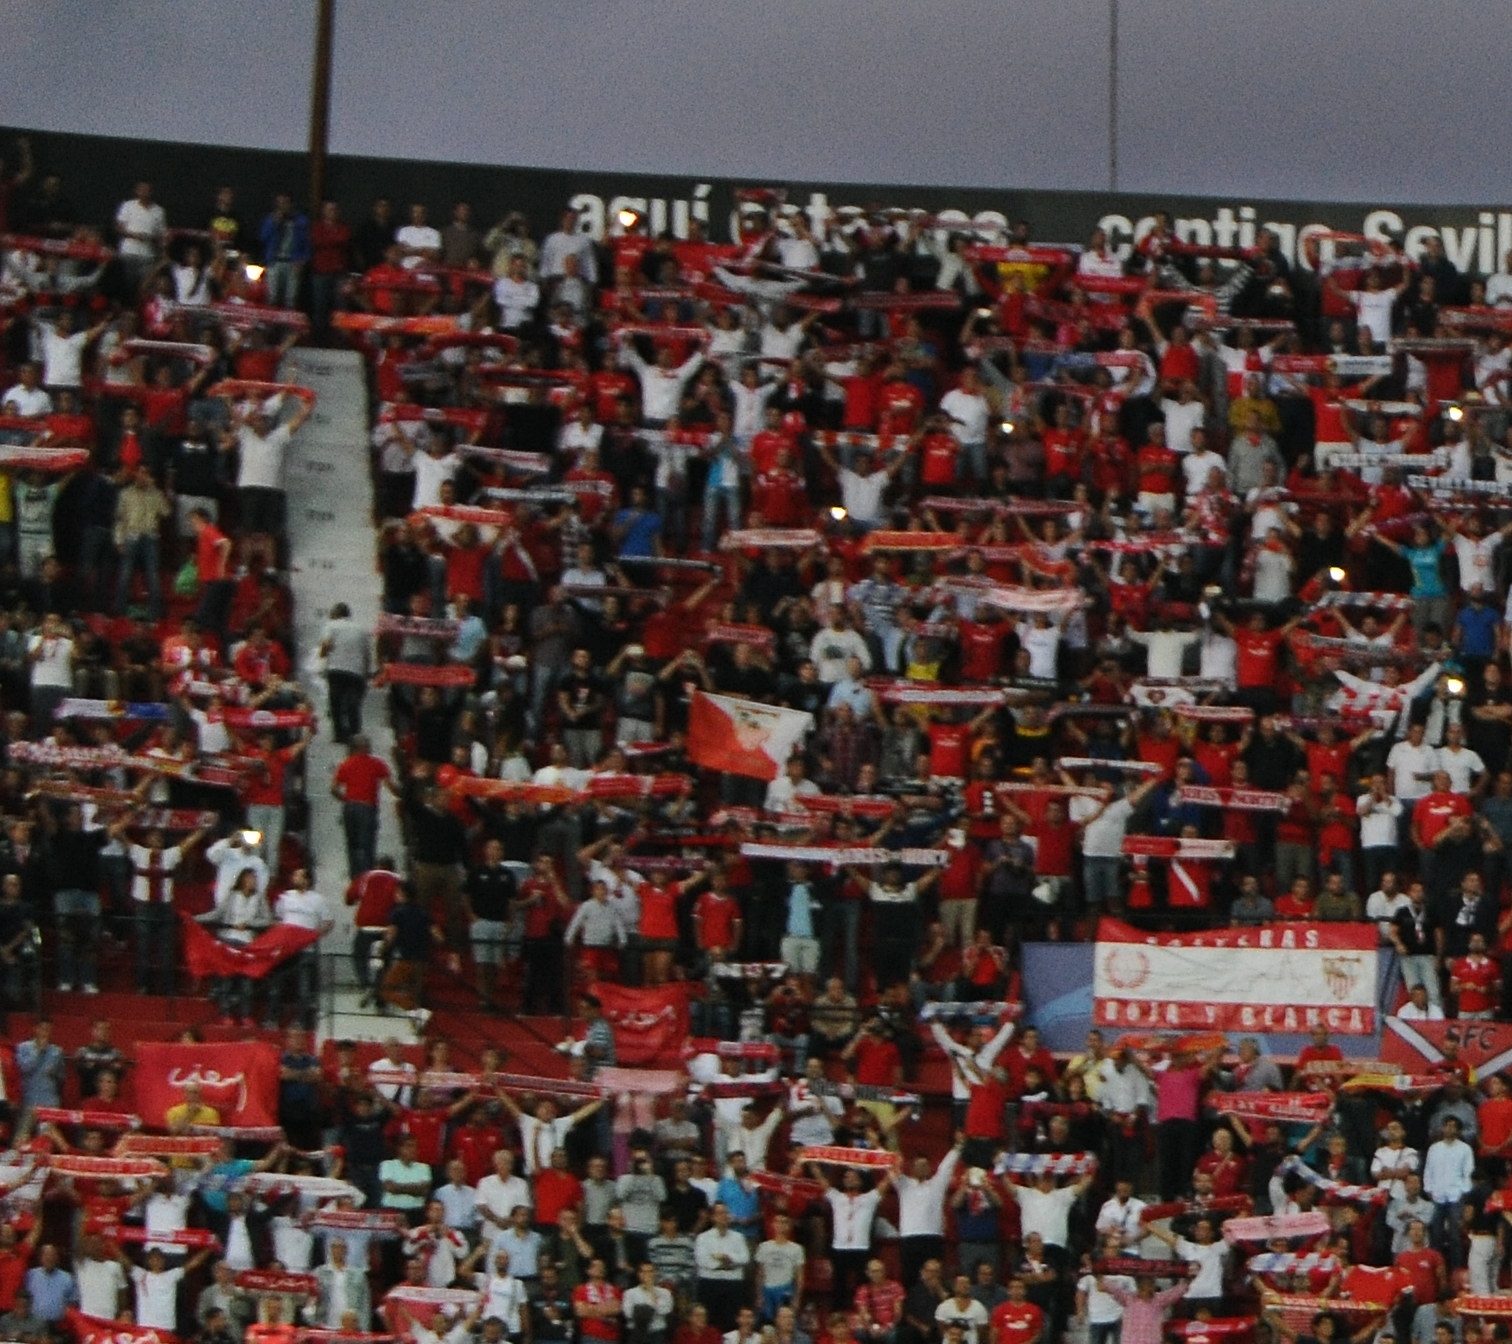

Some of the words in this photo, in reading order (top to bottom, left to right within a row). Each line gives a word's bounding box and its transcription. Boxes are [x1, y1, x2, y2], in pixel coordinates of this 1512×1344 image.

[1105, 1002, 1183, 1027] ROJA
[1201, 1006, 1217, 1027] Y
[1240, 1006, 1363, 1029] BLANCA
